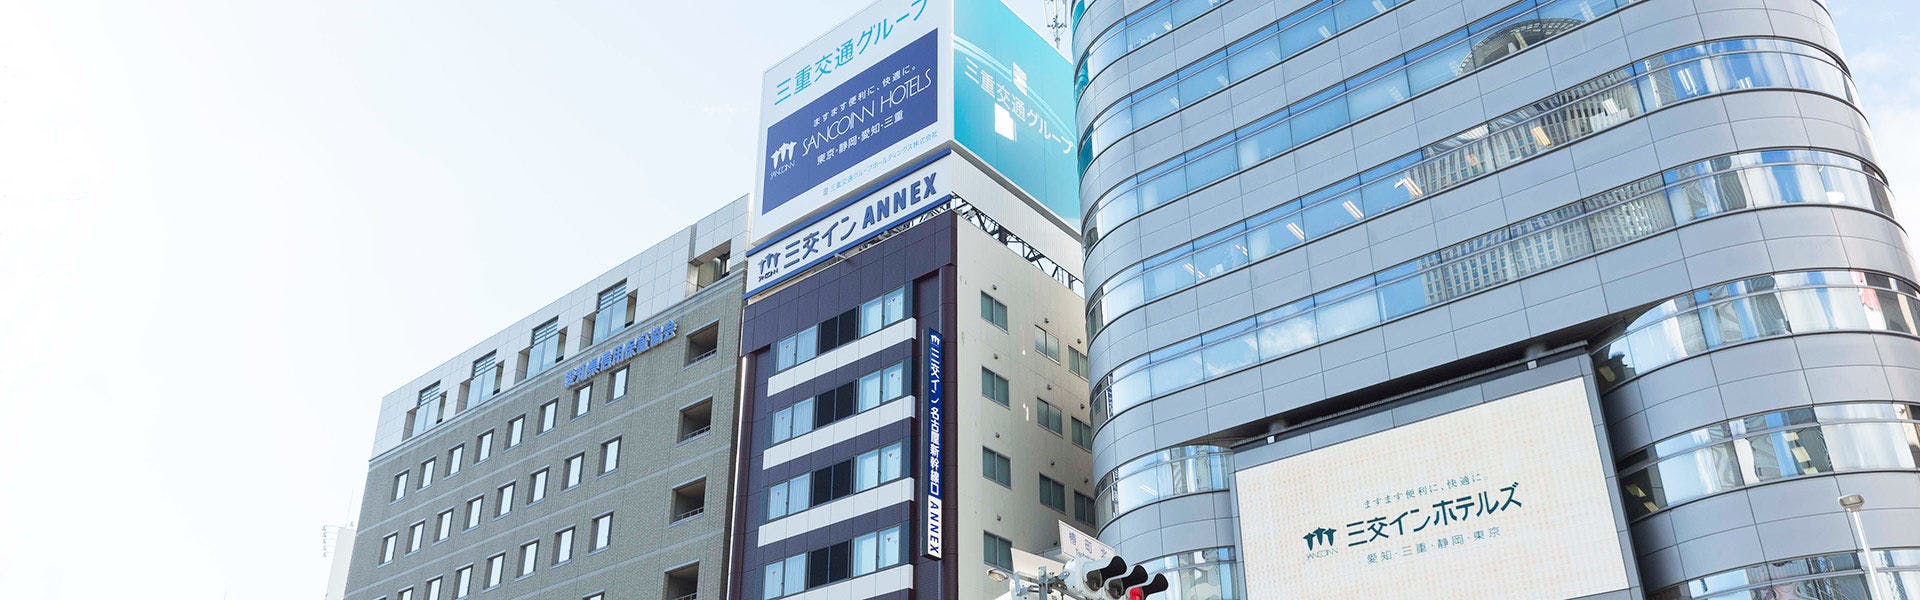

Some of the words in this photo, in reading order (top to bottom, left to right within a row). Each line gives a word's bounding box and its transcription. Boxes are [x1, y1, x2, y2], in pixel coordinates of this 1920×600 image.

[880, 68, 932, 113] HOTELS
[964, 56, 1074, 154] 三重交通グループ
[783, 215, 857, 269] 三交イン
[862, 172, 937, 229] ANNEX
[930, 500, 939, 554] ANNEX
[1346, 481, 1523, 547] 三交インホテルズ
